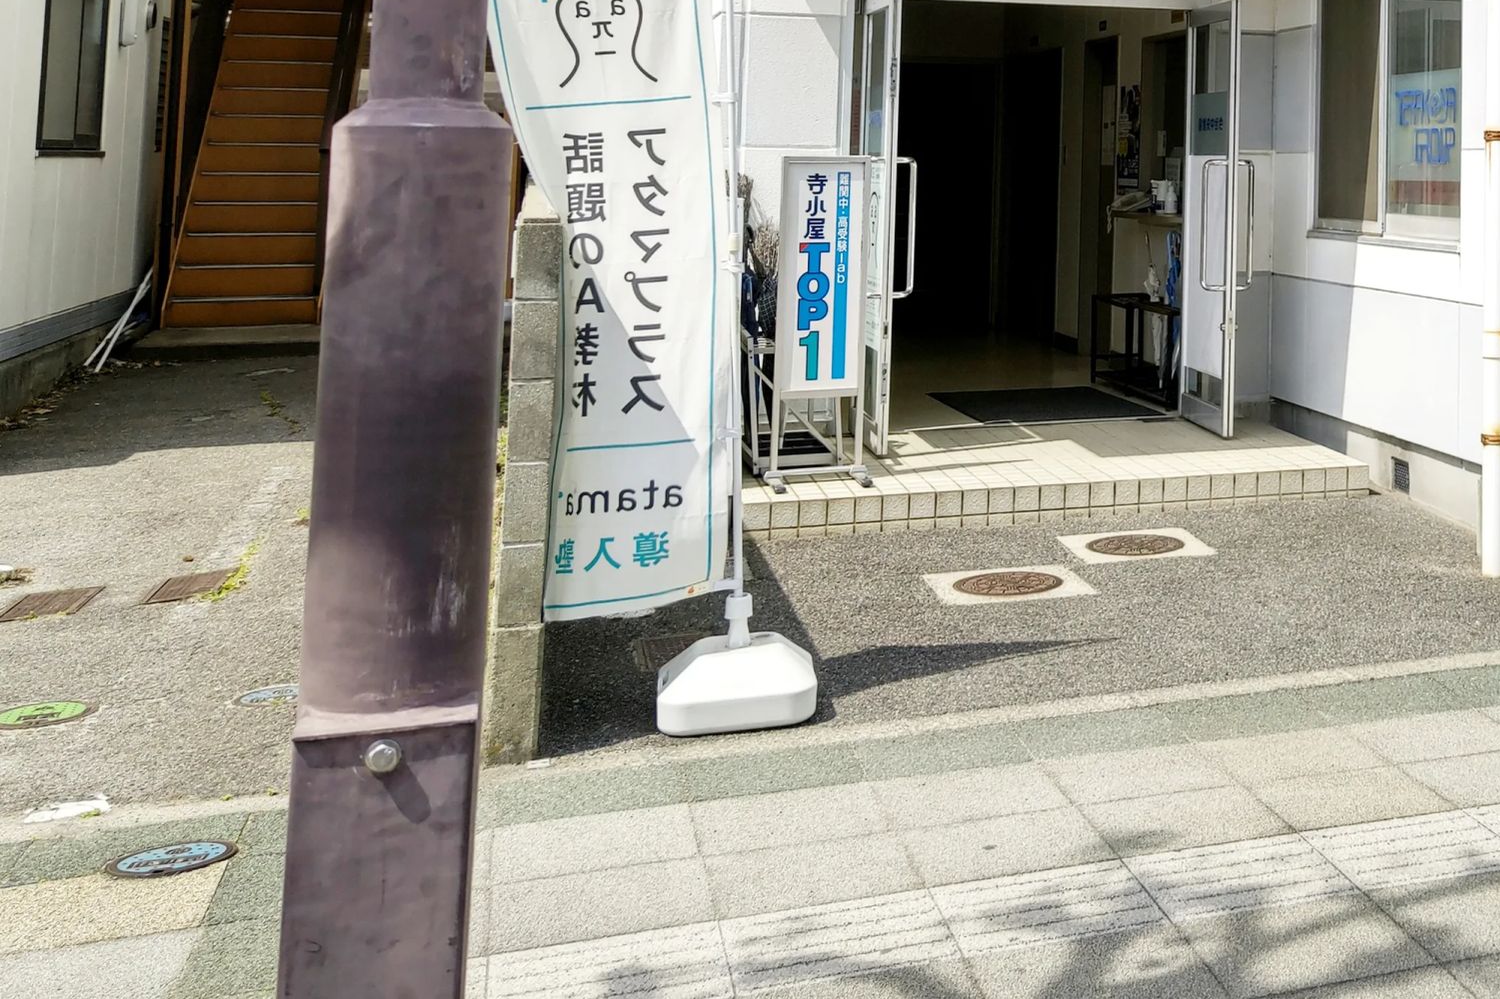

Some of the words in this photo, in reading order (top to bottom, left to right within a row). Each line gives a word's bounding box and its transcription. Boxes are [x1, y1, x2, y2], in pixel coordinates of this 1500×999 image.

[803, 173, 828, 239] 寺小屋
[797, 241, 830, 380] TOP1
